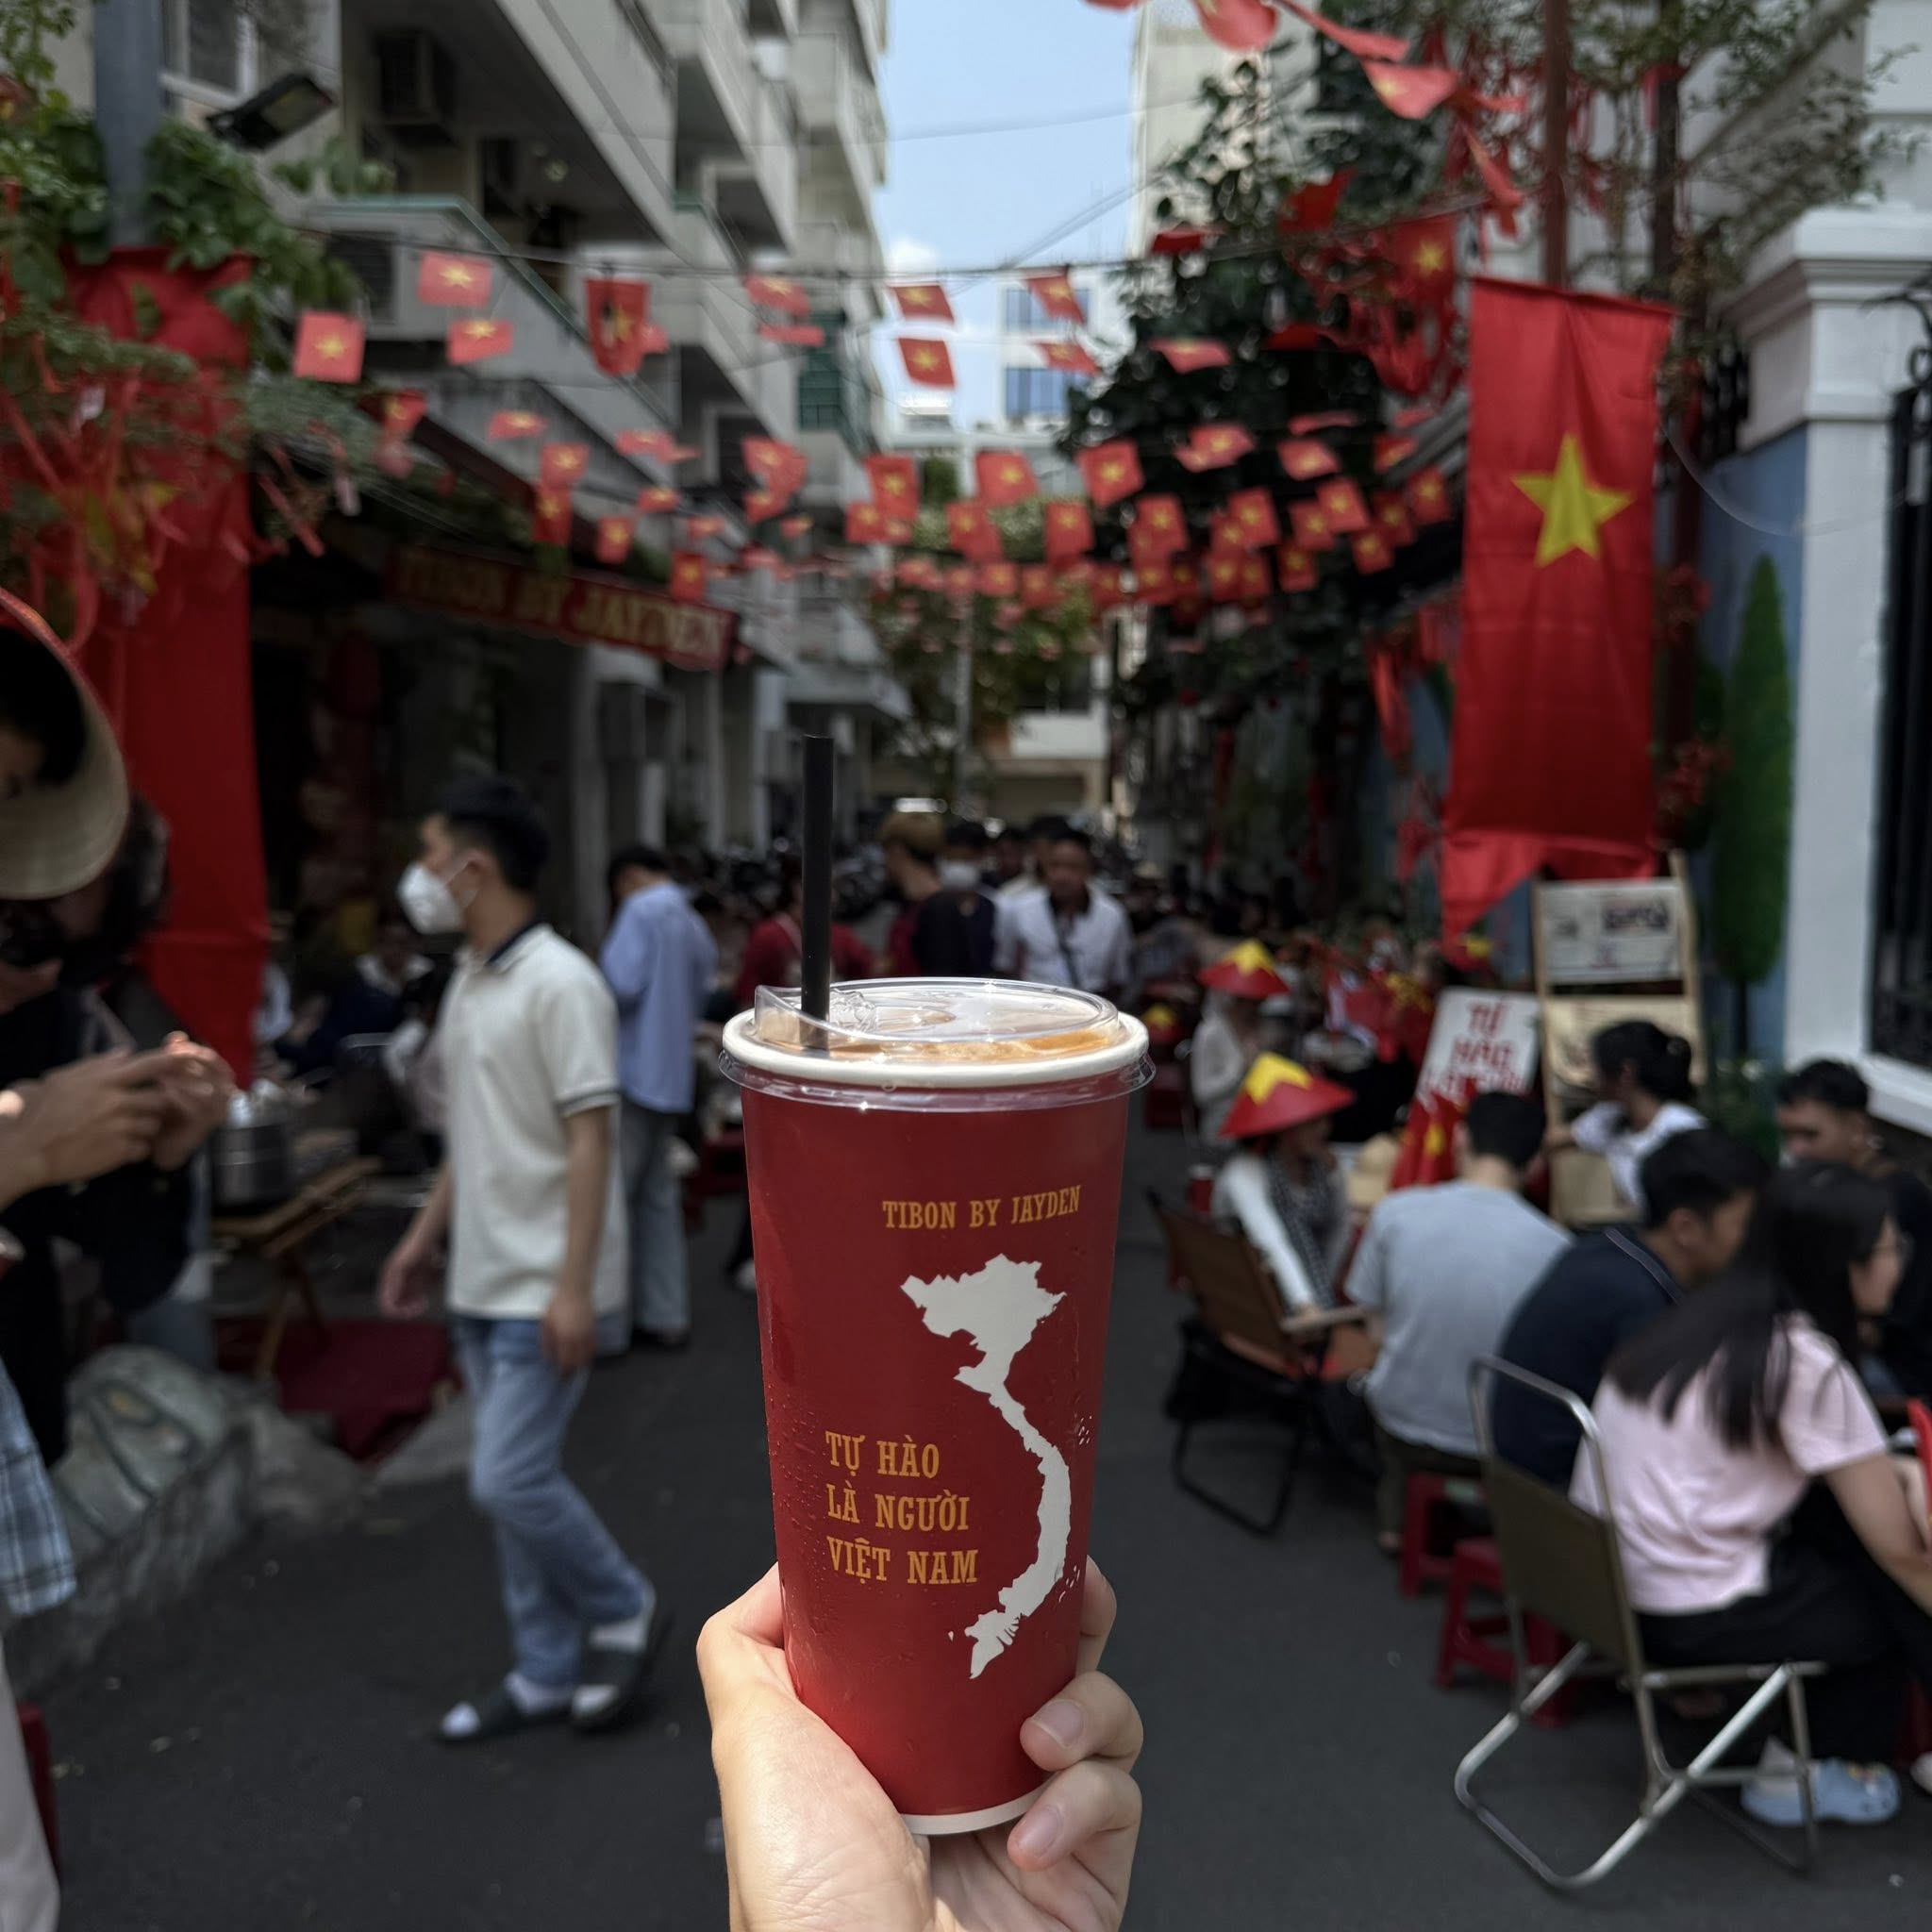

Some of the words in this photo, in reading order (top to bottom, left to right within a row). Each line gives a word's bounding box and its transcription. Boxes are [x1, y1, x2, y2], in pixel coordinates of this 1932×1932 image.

[883, 1201, 957, 1229] TIBON
[970, 1199, 1002, 1227] BY
[1011, 1185, 1081, 1224] JAYDEN
[825, 1430, 866, 1477] TỰ
[876, 1434, 941, 1479] HÀO
[825, 1479, 860, 1524] LÀ
[874, 1488, 970, 1532] NGƯỜI
[826, 1535, 891, 1585] VIỆT
[907, 1549, 978, 1586] NAM
